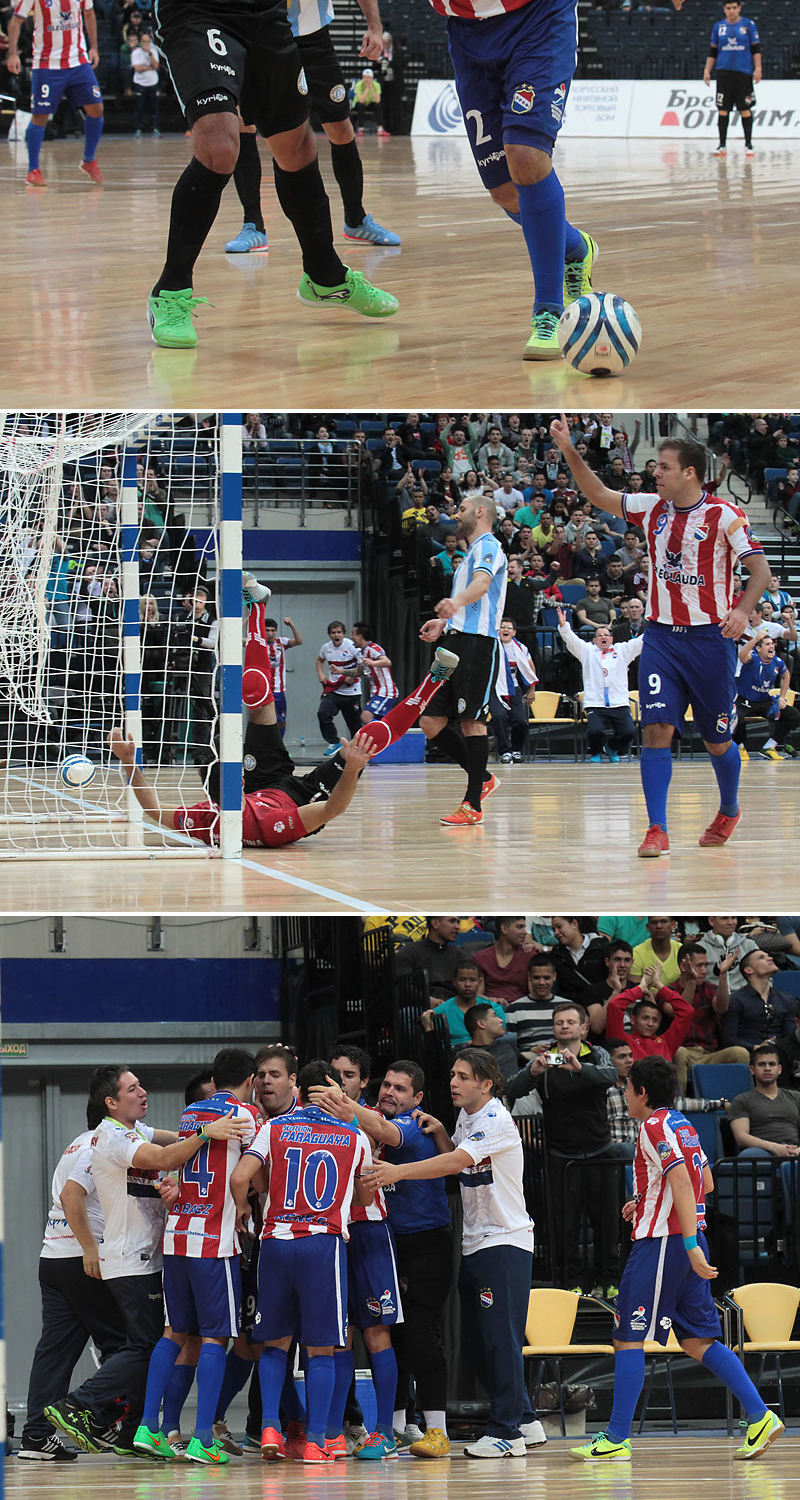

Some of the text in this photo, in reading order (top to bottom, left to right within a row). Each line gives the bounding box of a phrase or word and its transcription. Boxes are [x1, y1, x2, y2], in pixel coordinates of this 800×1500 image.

[206, 28, 227, 56] 6
[718, 26, 727, 37] 12
[41, 84, 50, 98] 9
[466, 109, 492, 146] 2
[653, 513, 668, 535] 9
[648, 673, 661, 695] 9
[280, 1131, 351, 1147] PARAGUAYA
[284, 1147, 339, 1212] 10
[181, 1203, 213, 1215] BAEZ
[247, 1294, 256, 1316] 9
